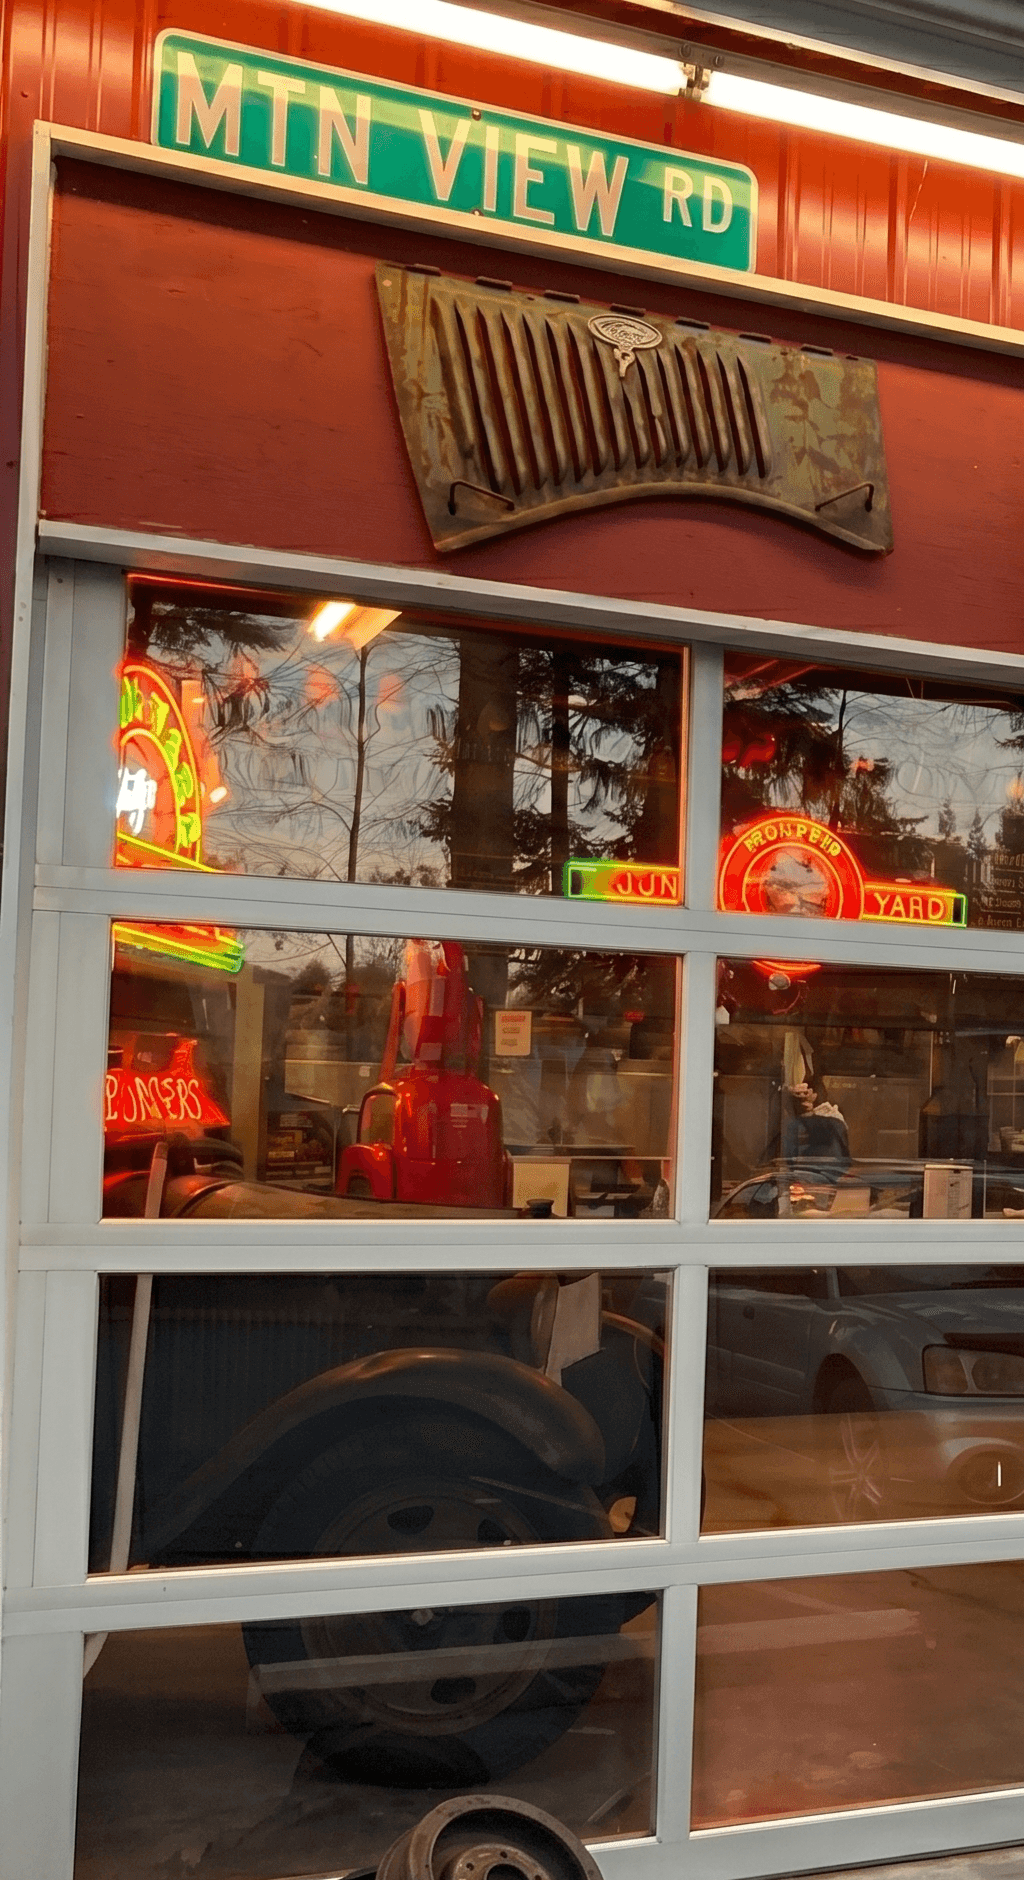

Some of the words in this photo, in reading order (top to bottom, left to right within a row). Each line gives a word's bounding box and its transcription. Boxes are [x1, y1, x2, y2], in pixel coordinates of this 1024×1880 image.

[174, 51, 372, 185] MTN
[418, 108, 629, 238] VIEW
[661, 166, 734, 236] RD
[873, 892, 944, 920] YARD
